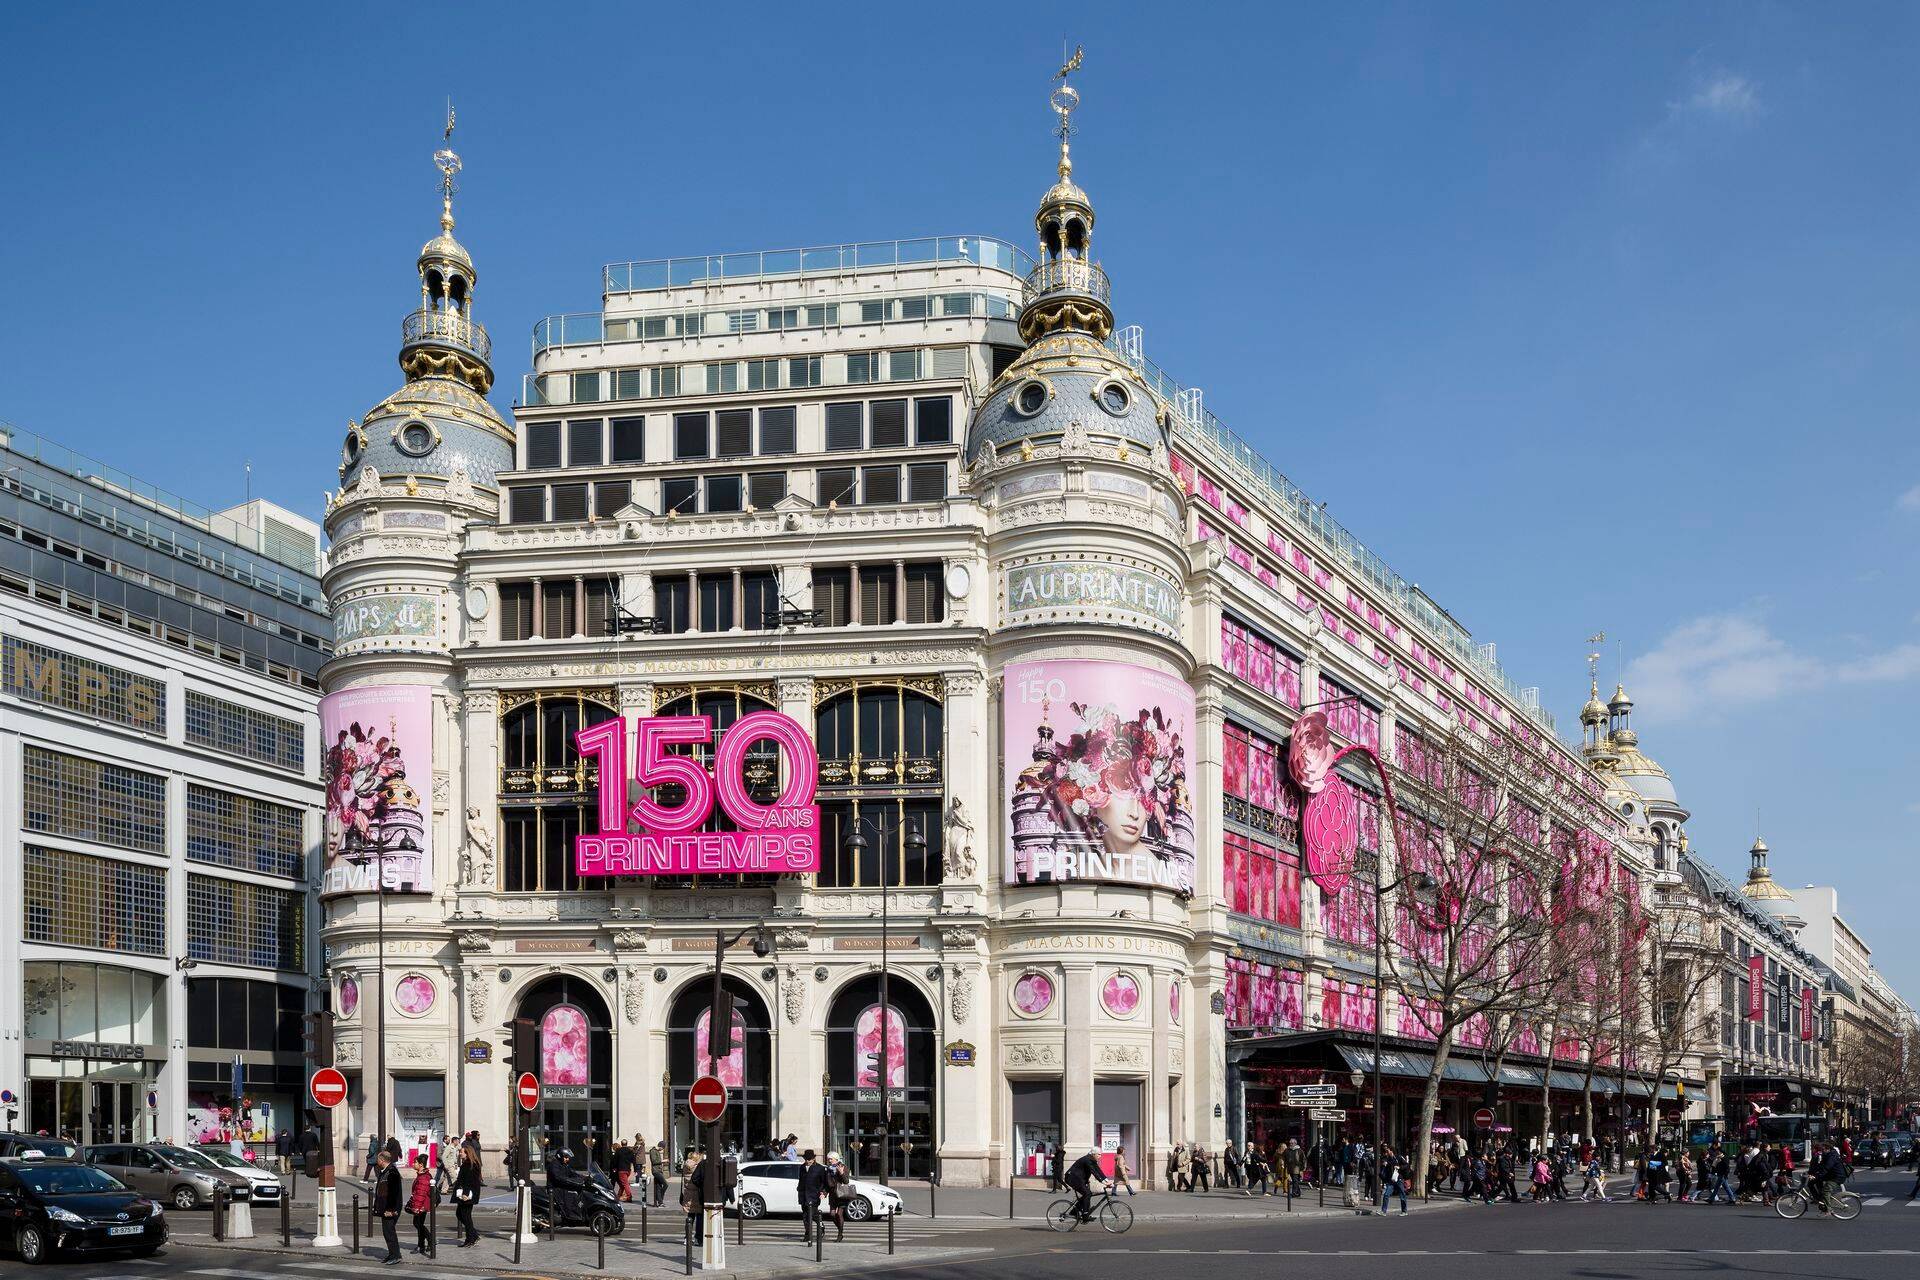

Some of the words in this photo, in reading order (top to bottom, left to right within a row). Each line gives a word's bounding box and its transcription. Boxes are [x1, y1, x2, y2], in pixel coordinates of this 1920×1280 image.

[1019, 576, 1055, 602] AU
[1064, 573, 1180, 620] PRINTEMP
[570, 660, 638, 676] GRANDS
[643, 657, 729, 673] MAGASINS
[763, 652, 860, 668] PRINTEMPS
[1016, 678, 1066, 704] 150
[574, 711, 817, 833] 150
[764, 809, 814, 828] ANS
[579, 834, 814, 871] PRINTEMPS
[1033, 852, 1192, 891] PRINTEMPS
[347, 941, 434, 957] PRINEMPS
[1026, 936, 1115, 950] MAGASINS
[1124, 938, 1142, 950] DU
[51, 1041, 144, 1059] PRINTEMPS
[546, 1087, 584, 1095] PRINTEMPS
